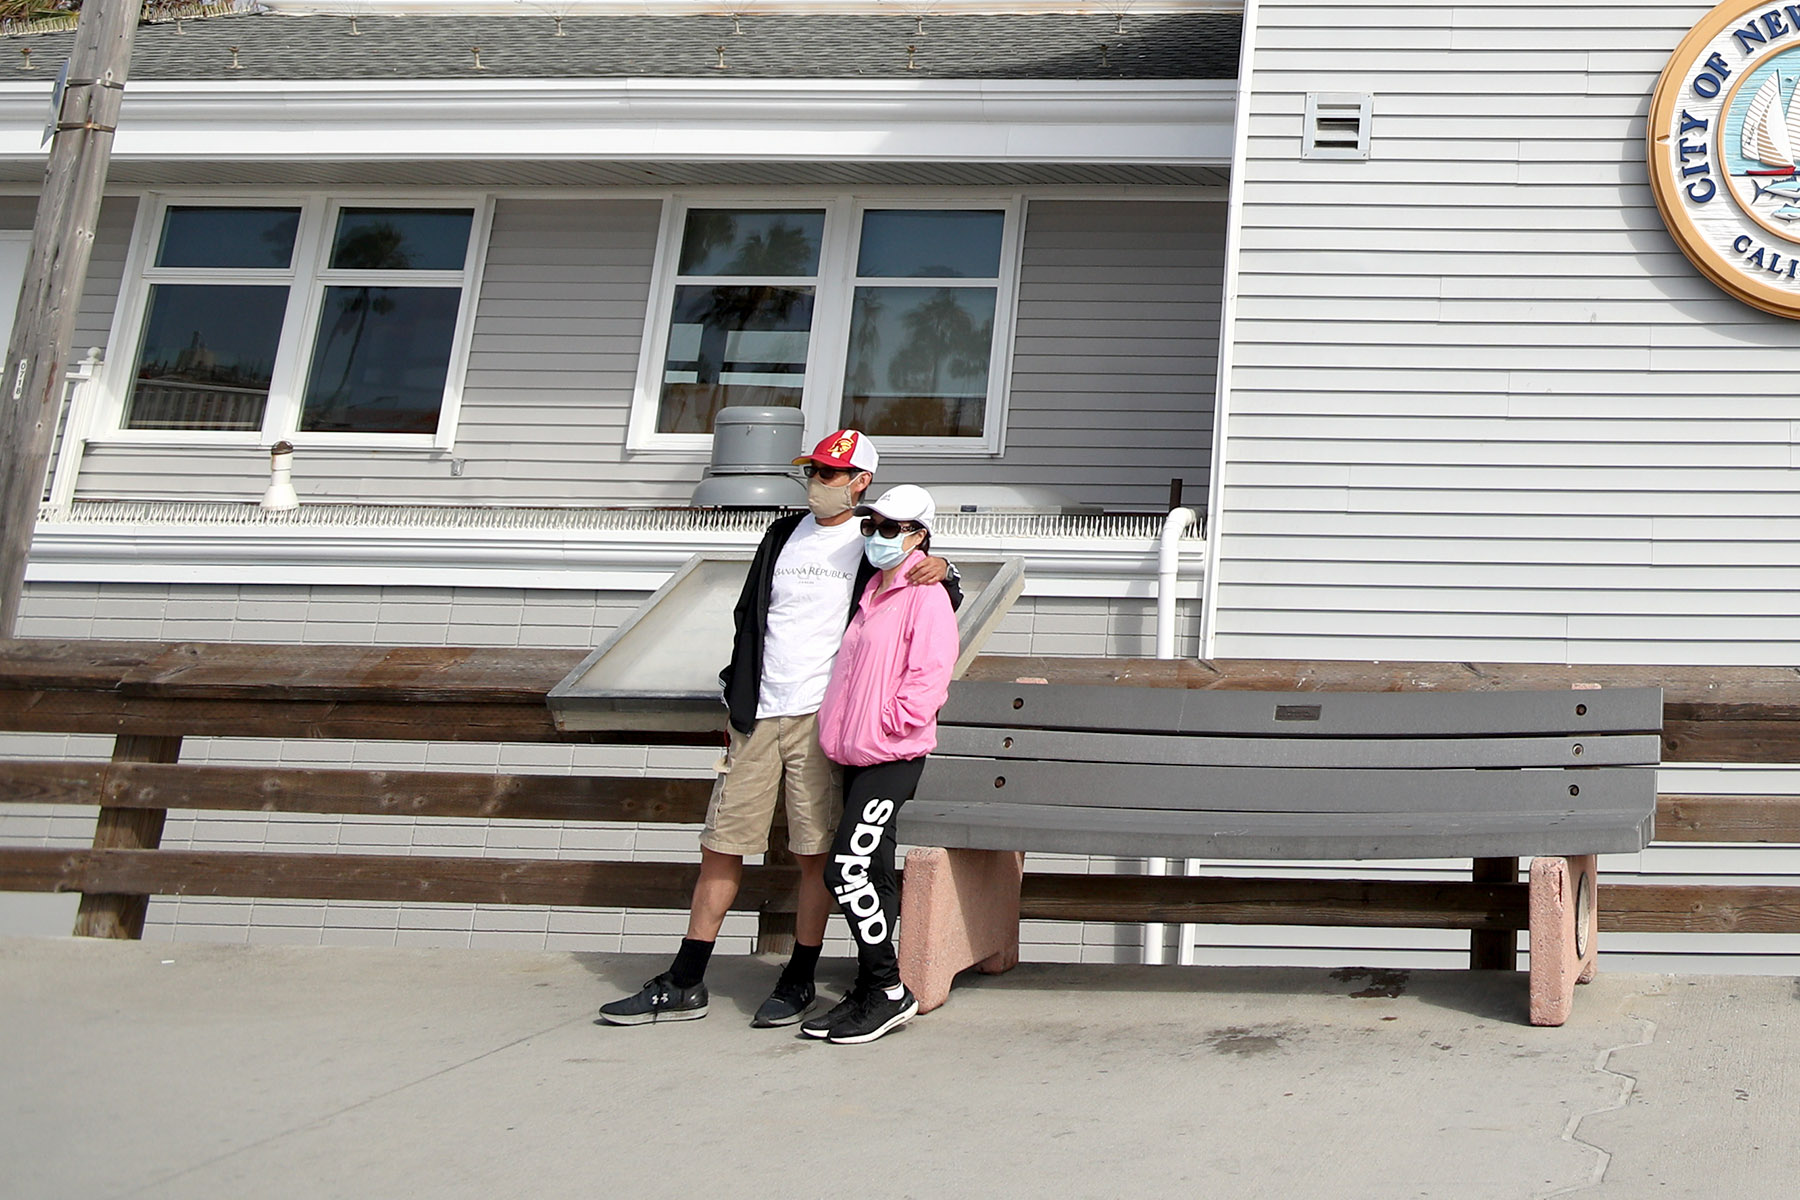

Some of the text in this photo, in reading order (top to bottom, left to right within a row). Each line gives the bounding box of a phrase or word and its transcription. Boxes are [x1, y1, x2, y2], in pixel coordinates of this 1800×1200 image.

[1693, 51, 1732, 99] OF
[1680, 109, 1717, 204] CITY
[808, 566, 854, 581] REPUBLIC
[834, 798, 895, 945] adidas
